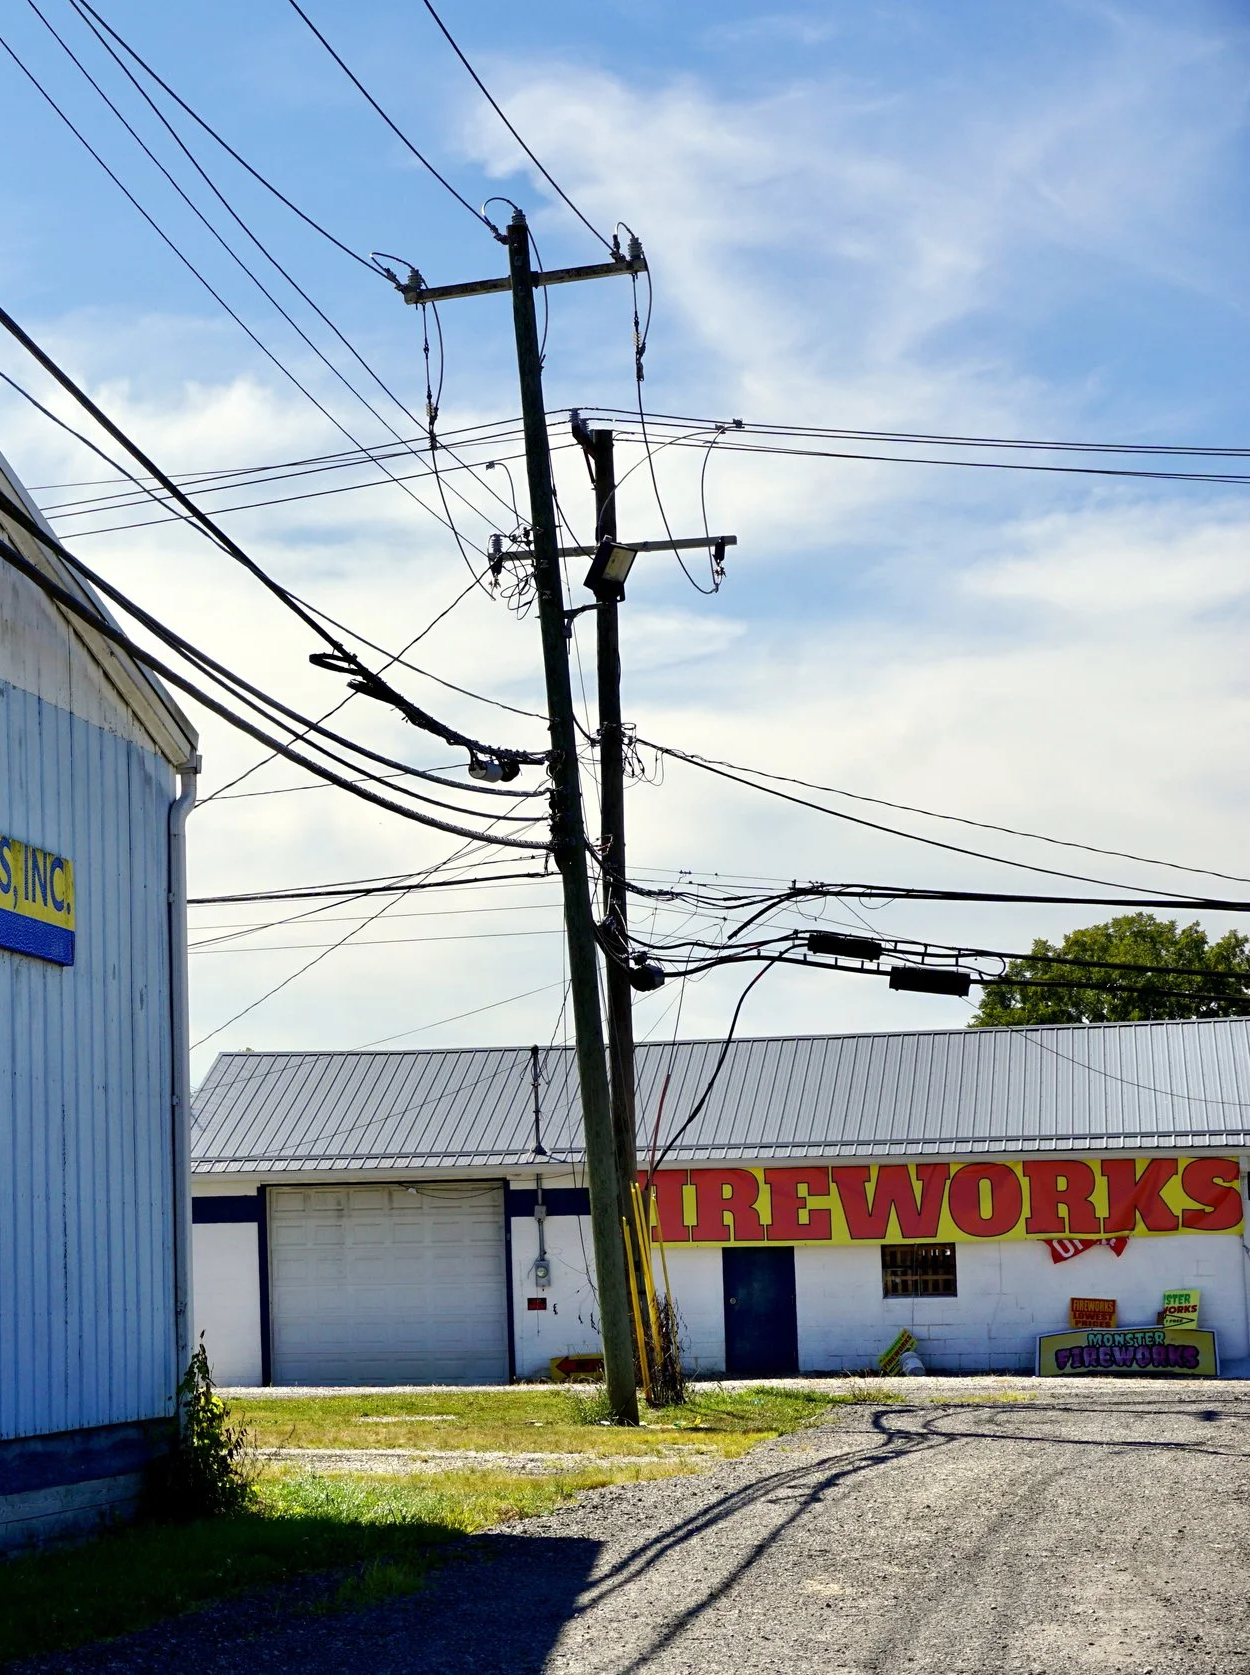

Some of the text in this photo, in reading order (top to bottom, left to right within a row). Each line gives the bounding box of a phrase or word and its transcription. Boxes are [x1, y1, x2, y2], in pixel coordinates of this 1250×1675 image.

[23, 847, 72, 916] INC.
[637, 1157, 1244, 1242] IREWORKS
[1073, 1299, 1114, 1312] FIREWORKS
[1073, 1311, 1112, 1321] LOWEST
[1074, 1319, 1112, 1329] PRICES
[1087, 1331, 1166, 1347] MONSTER
[1054, 1344, 1200, 1371] FIREWORKS
